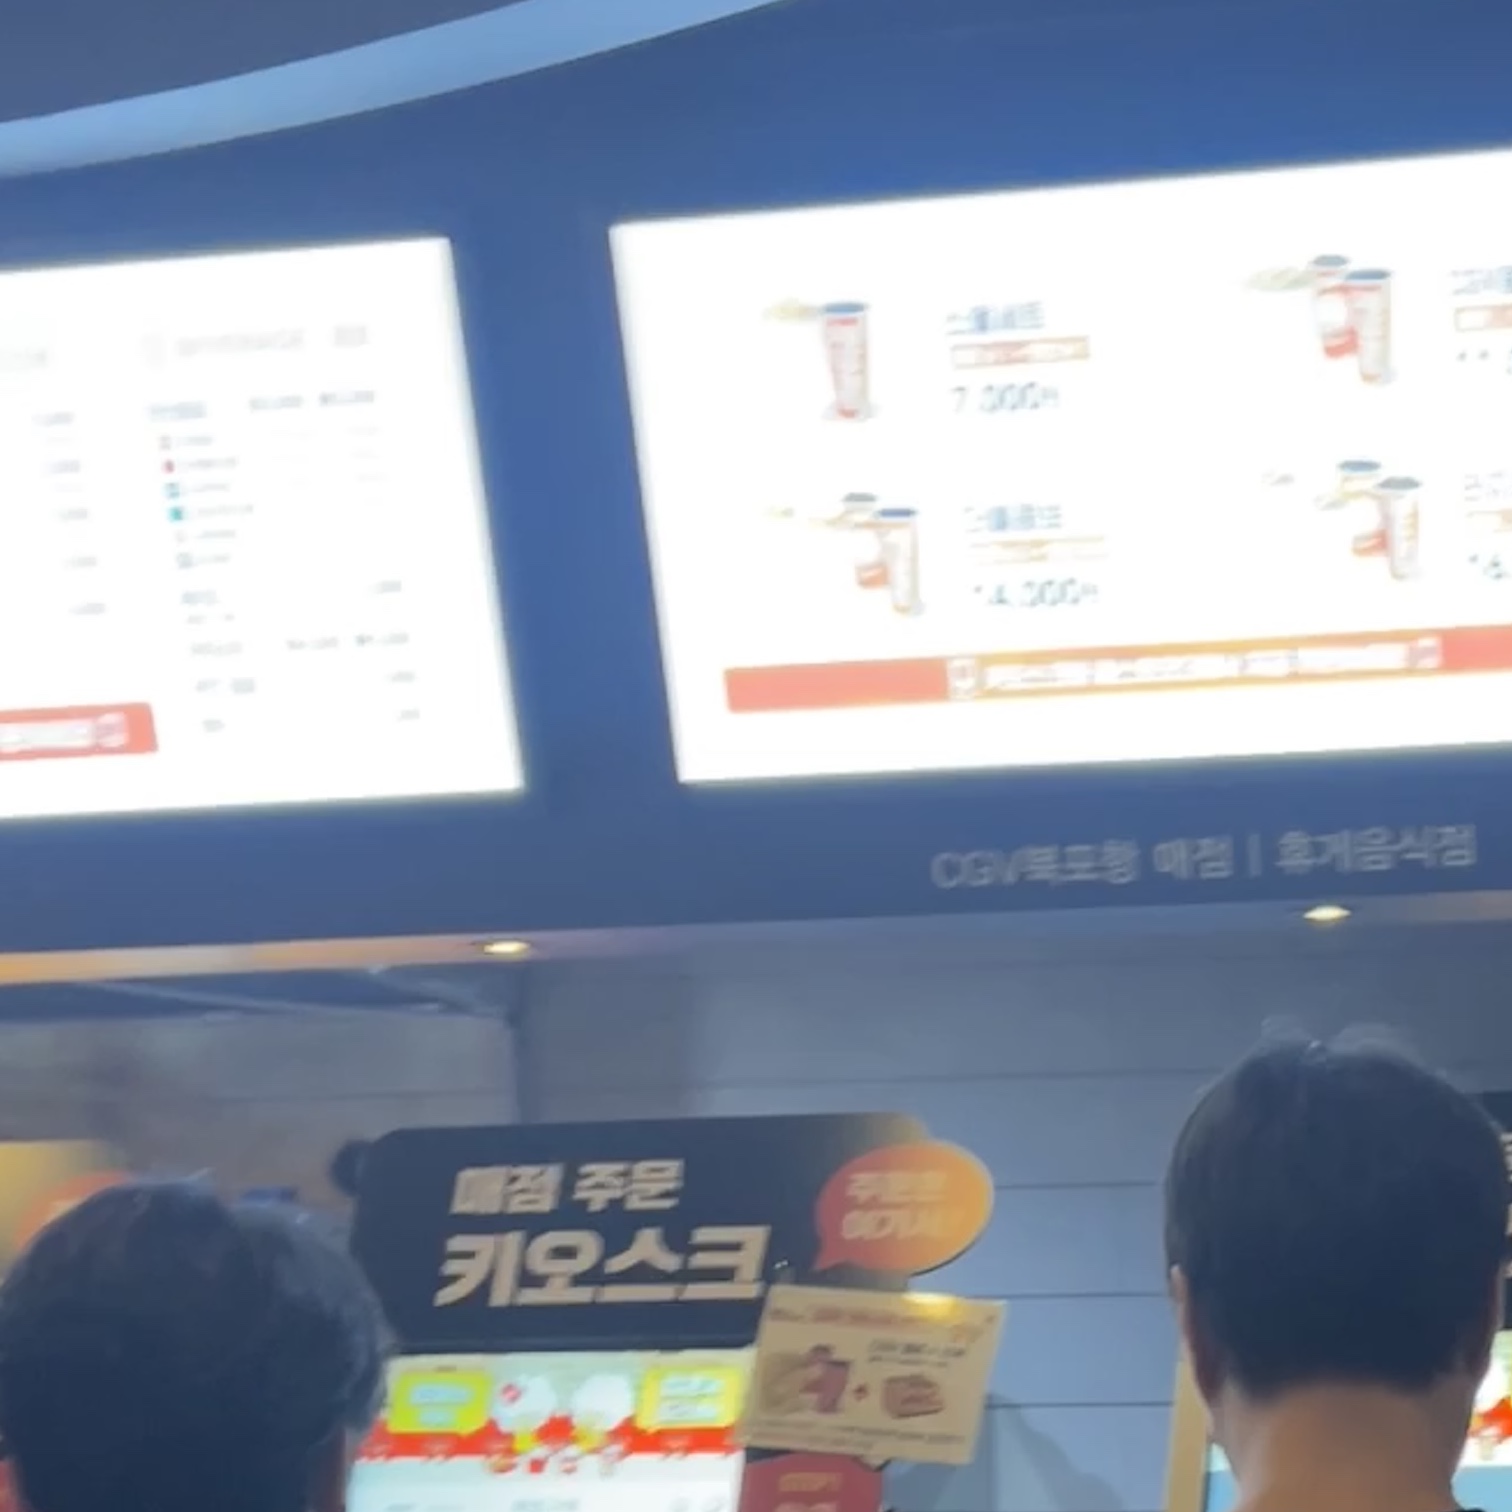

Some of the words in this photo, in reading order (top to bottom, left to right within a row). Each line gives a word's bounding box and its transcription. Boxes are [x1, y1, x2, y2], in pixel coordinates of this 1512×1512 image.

[1153, 835, 1233, 879] 매점
[1277, 825, 1477, 874] 휴게음식점
[448, 1161, 564, 1215] 매점
[572, 1157, 684, 1211] 주문
[434, 1226, 771, 1308] 키오스크
